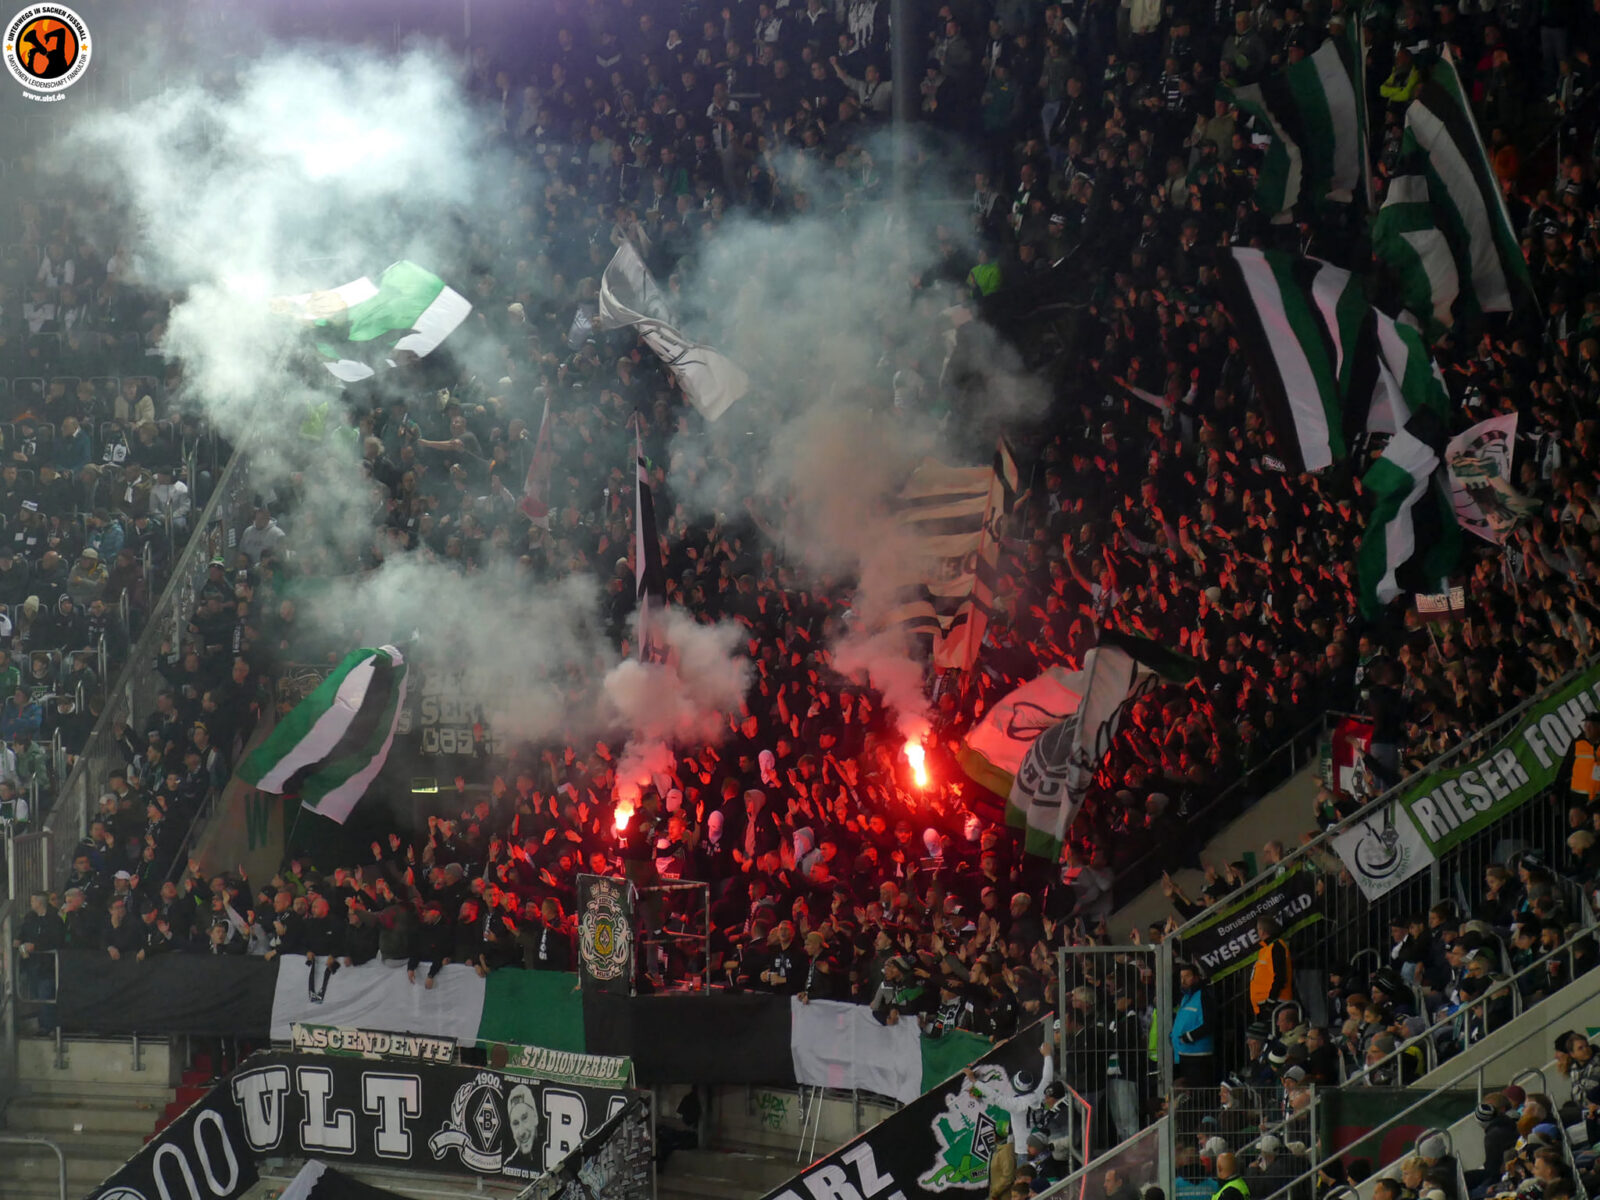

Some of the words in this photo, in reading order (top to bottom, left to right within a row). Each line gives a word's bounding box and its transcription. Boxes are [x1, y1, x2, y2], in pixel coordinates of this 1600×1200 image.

[1410, 748, 1530, 843] RIESER
[1217, 893, 1285, 937] Borussen-Fohlen
[297, 1027, 455, 1062] ASCENDENTE
[521, 1046, 625, 1079] STADIONVERBOT
